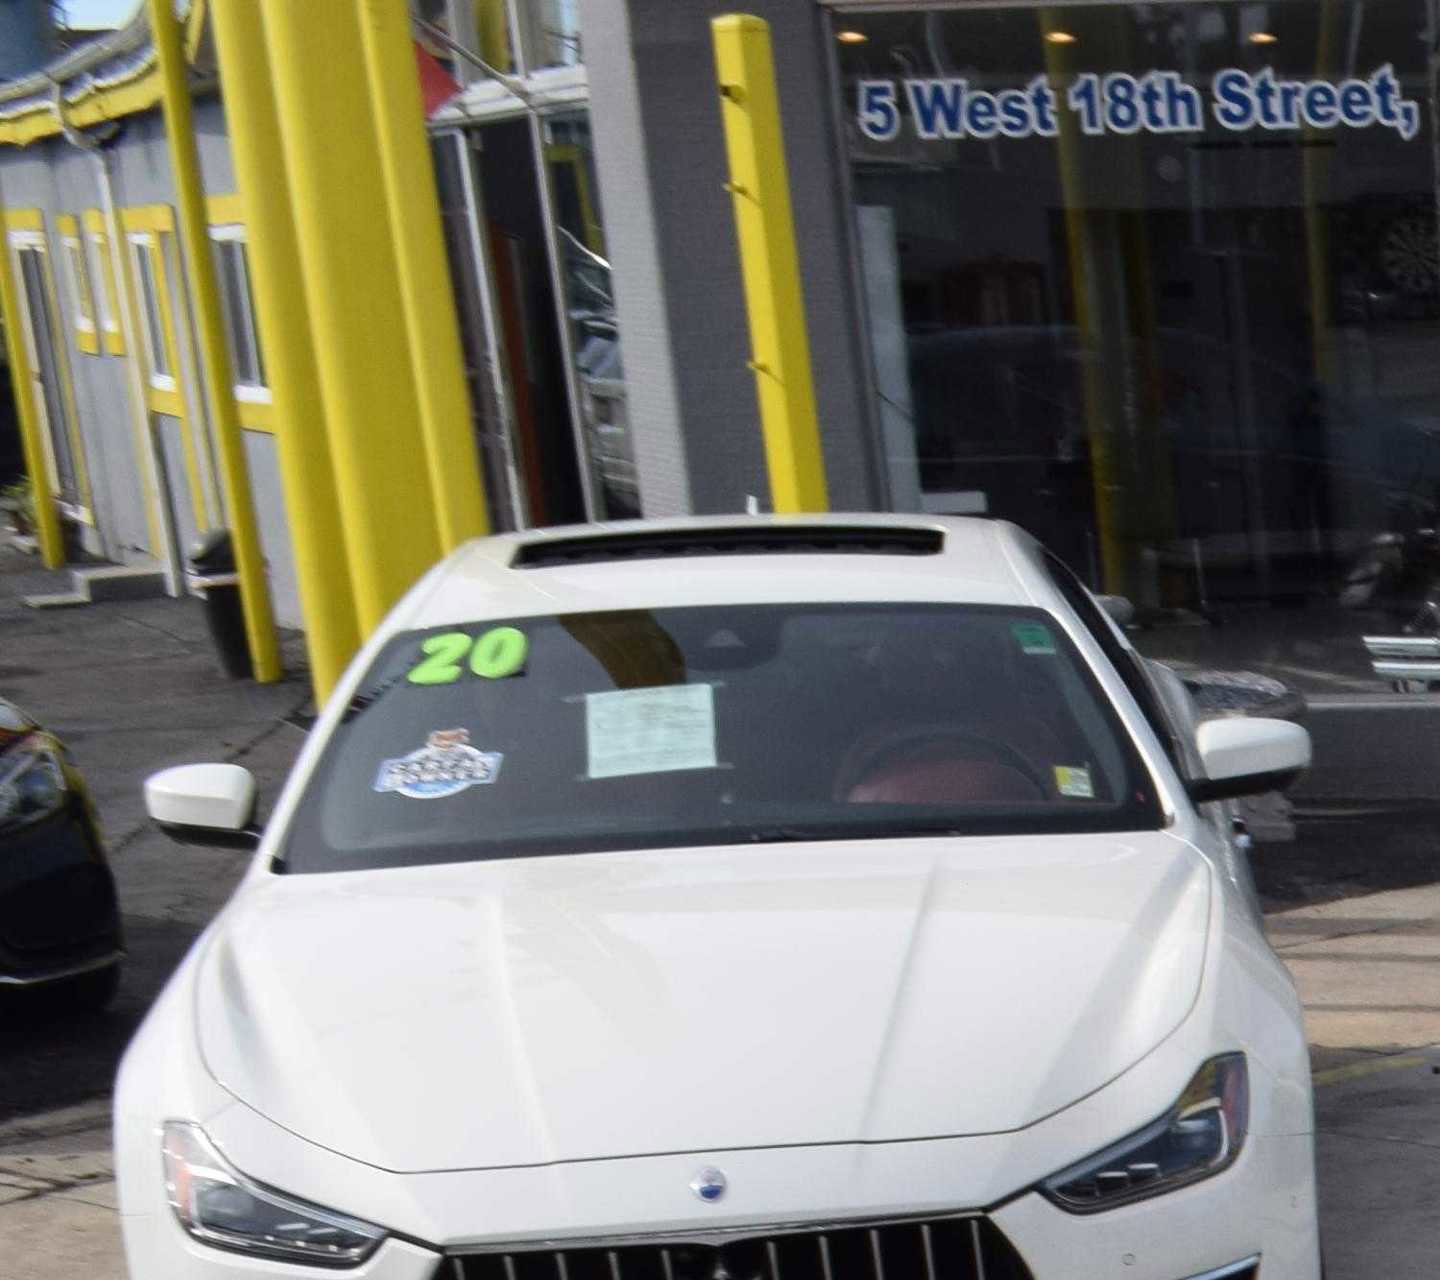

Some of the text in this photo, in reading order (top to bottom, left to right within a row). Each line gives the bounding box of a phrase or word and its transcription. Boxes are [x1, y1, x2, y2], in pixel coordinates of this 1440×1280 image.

[858, 64, 1420, 141] 5 West 18th Street,
[407, 627, 529, 684] 20
